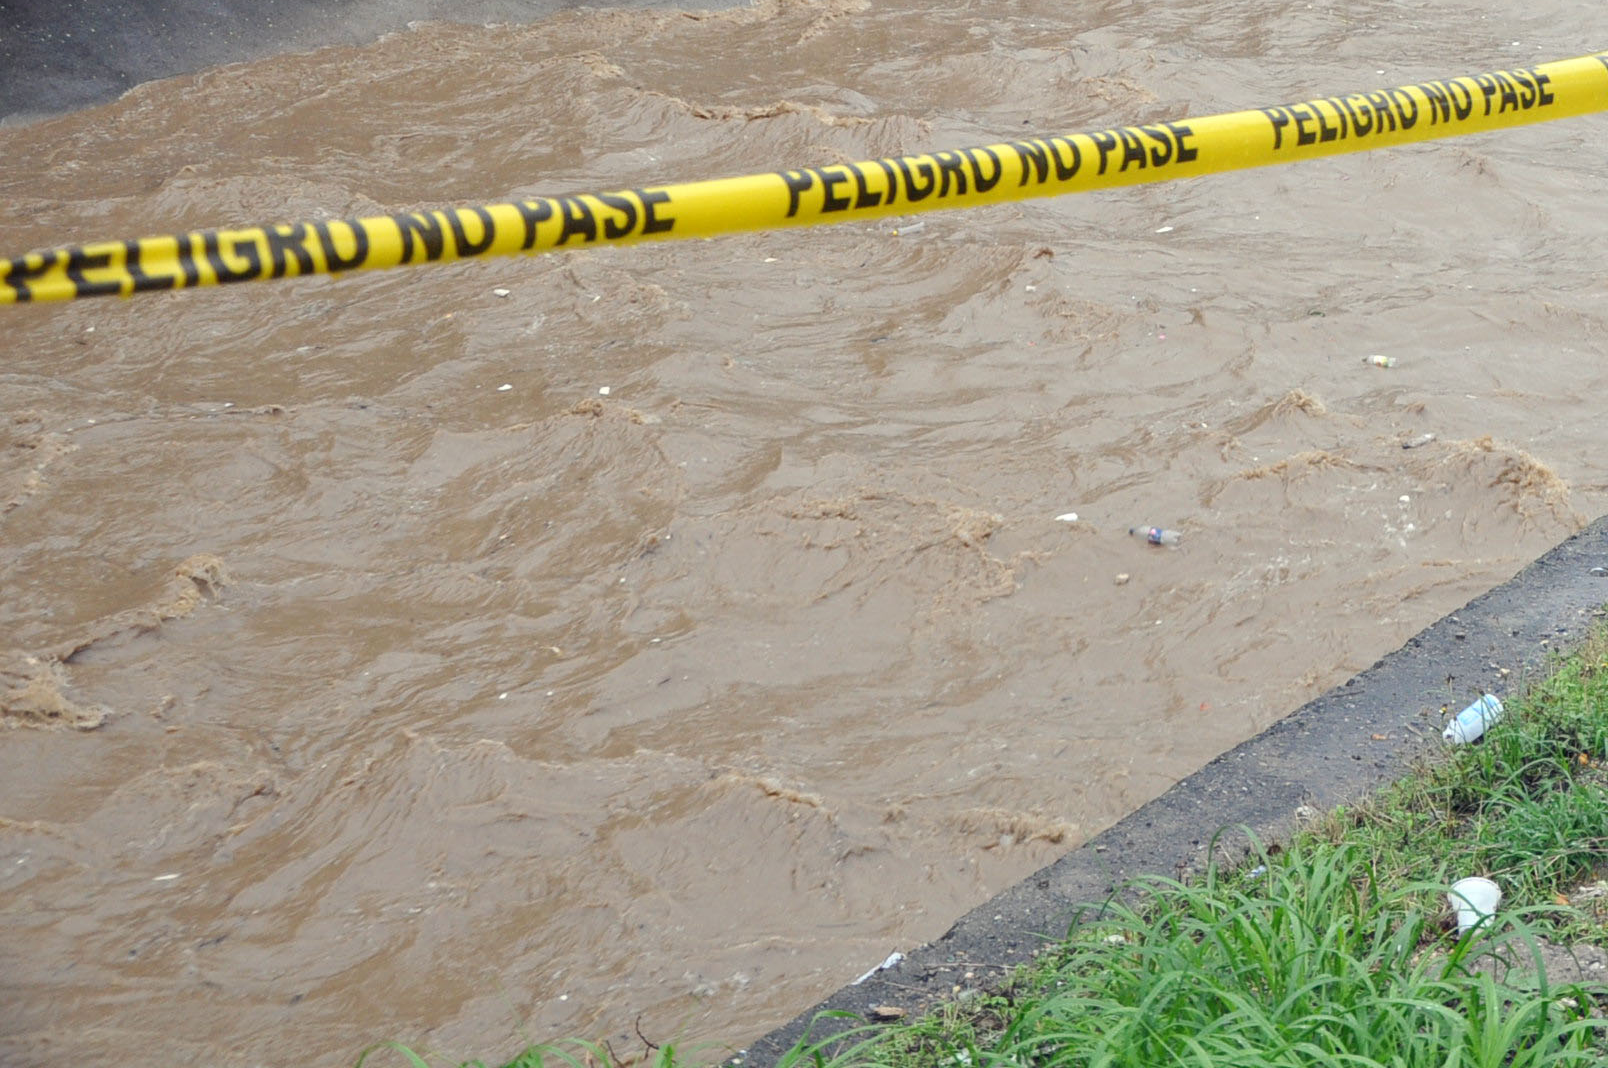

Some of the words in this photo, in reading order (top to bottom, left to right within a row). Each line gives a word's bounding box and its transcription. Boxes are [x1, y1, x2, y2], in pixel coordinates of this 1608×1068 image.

[1262, 88, 1418, 150] PELIGRO
[1416, 79, 1472, 125] NO
[1474, 65, 1555, 116] PASE
[779, 147, 1001, 218] PELIGRO
[1007, 135, 1081, 186] NO
[1091, 120, 1198, 175] PASE
[4, 218, 369, 302] PELIGRO
[398, 206, 497, 265] NO
[515, 188, 676, 251] PASE
